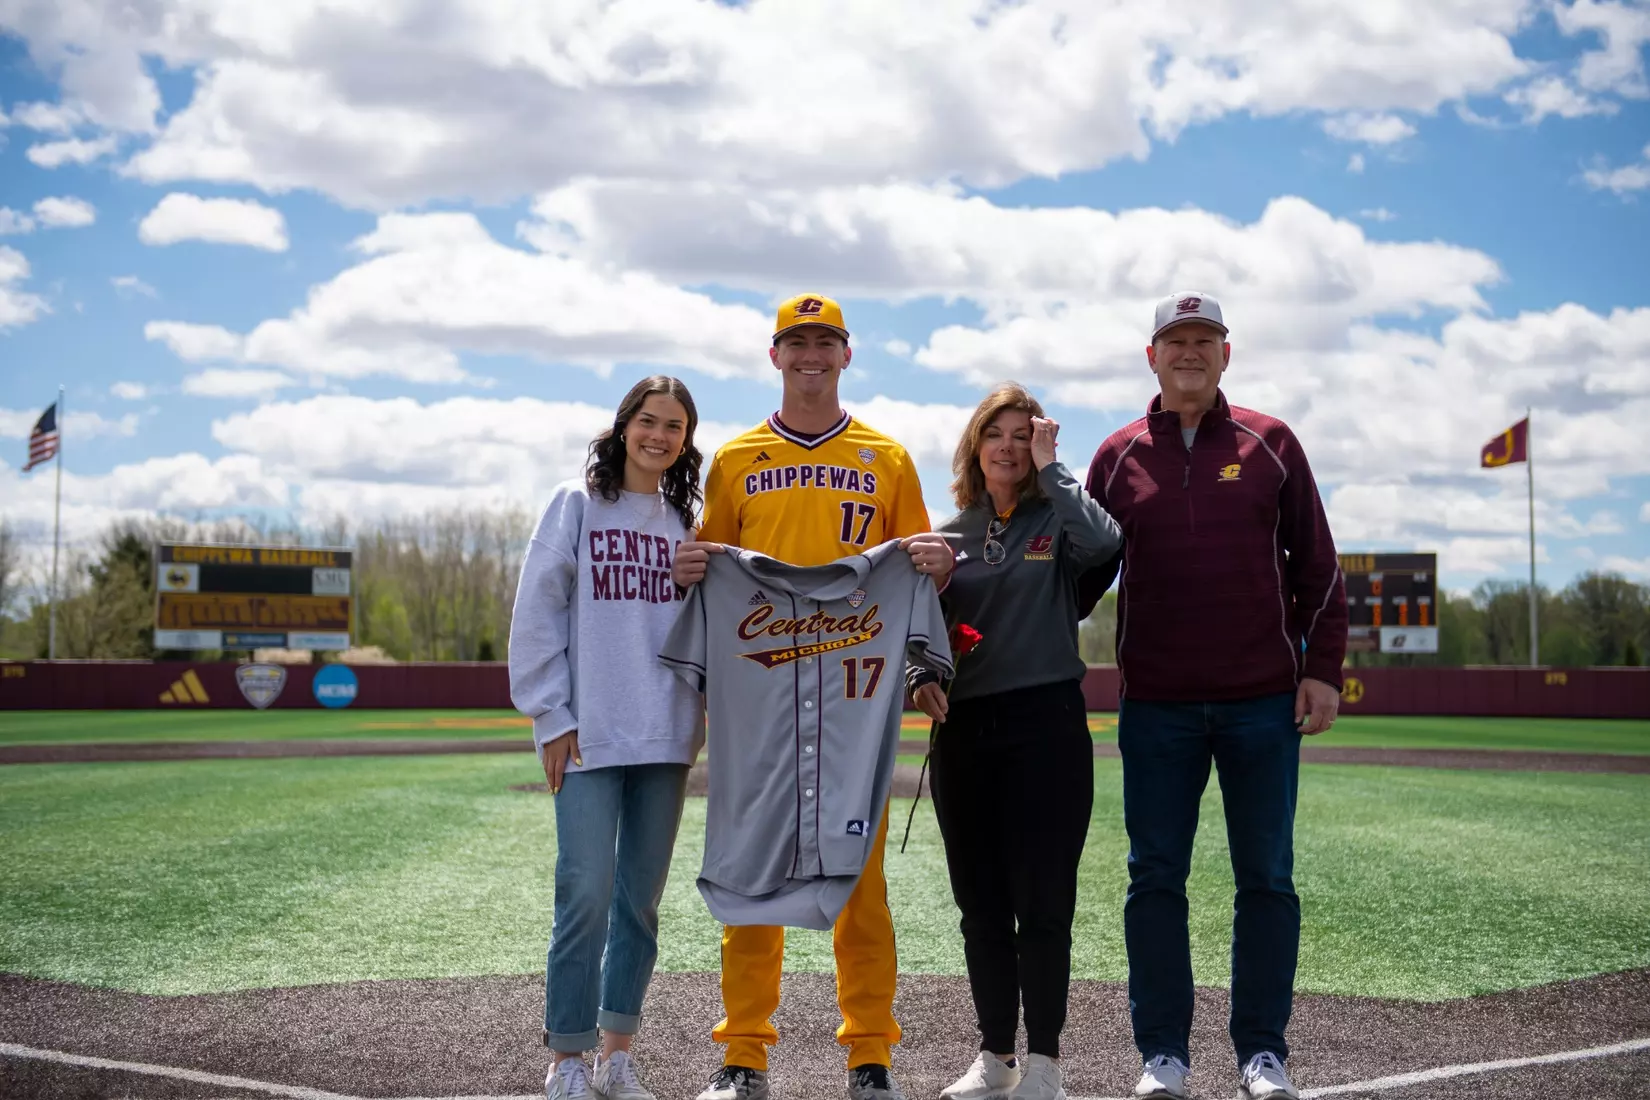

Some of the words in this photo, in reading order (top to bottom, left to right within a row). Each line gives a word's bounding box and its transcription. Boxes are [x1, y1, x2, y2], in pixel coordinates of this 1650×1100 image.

[744, 464, 877, 496] CHIPPEWAS
[840, 500, 876, 546] 17
[259, 549, 337, 567] BASEBALL
[589, 529, 681, 569] CENTR
[737, 603, 884, 641] Central
[769, 632, 873, 663] MICHIGAN
[842, 656, 886, 700] 17
